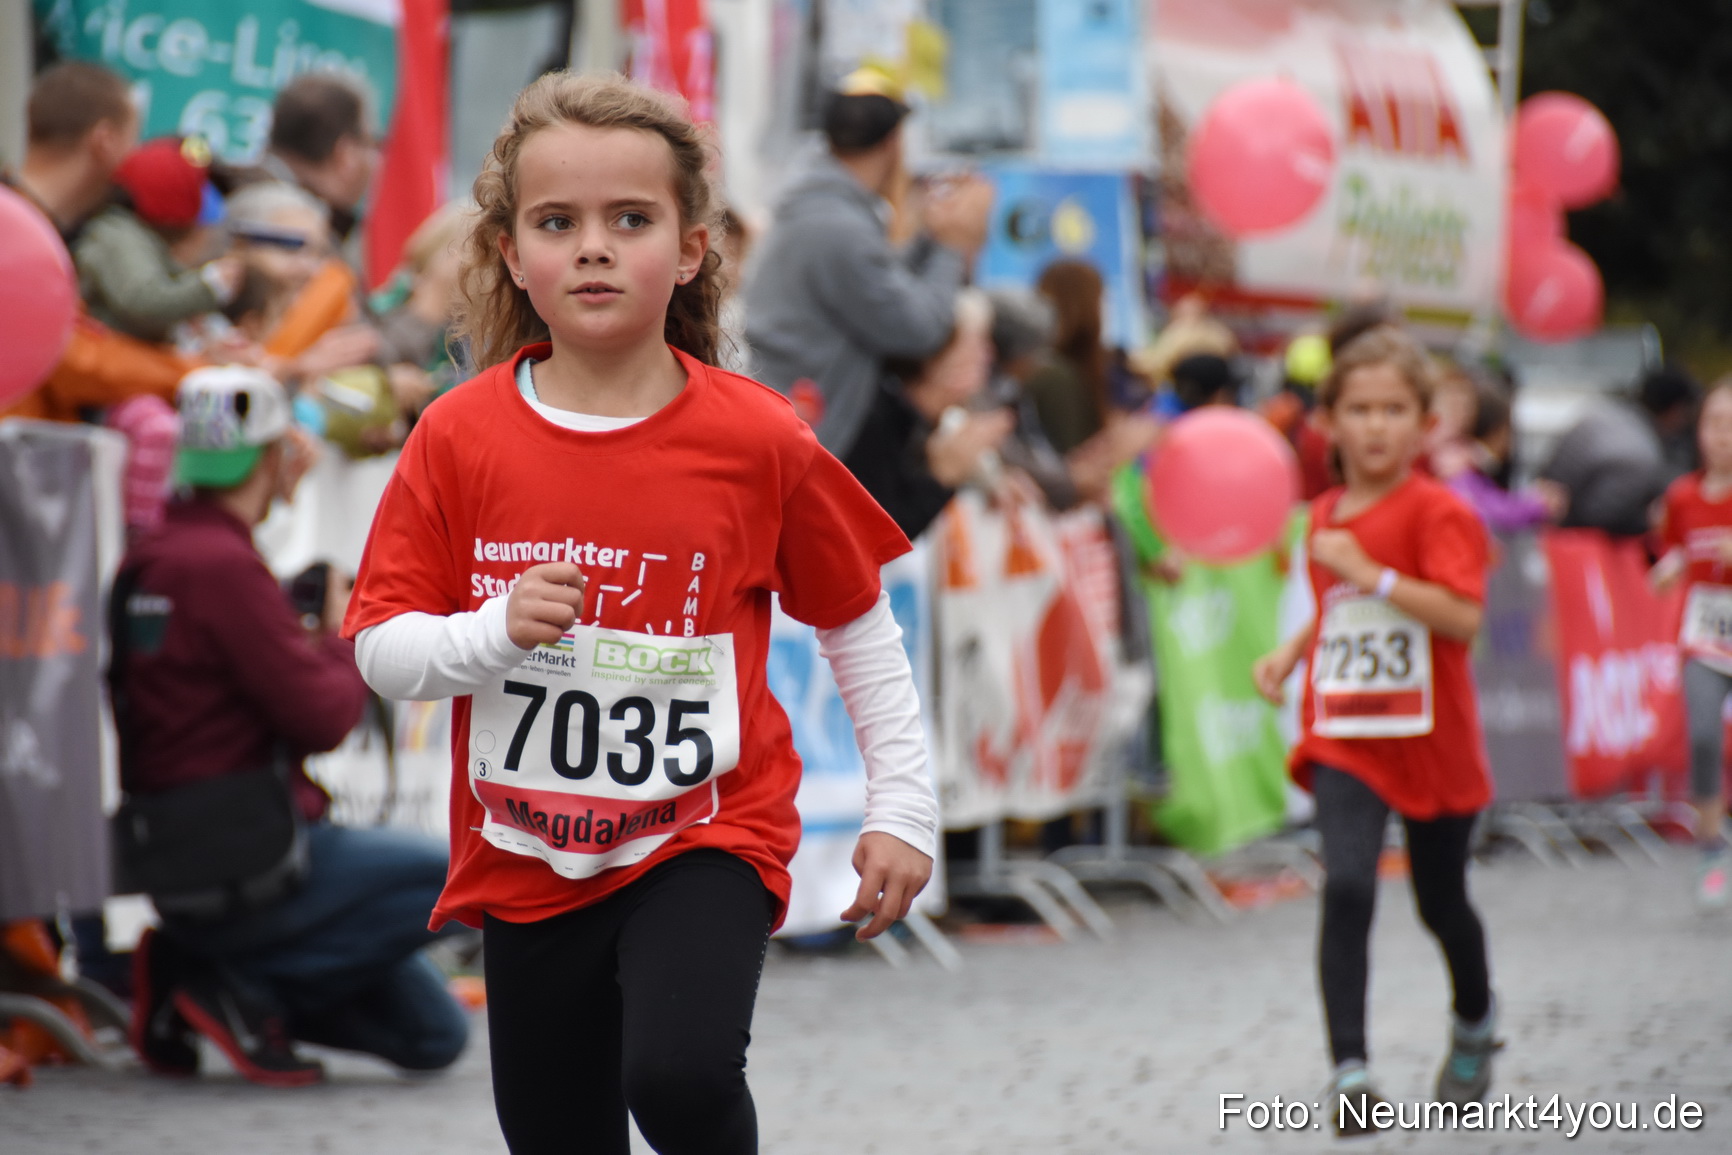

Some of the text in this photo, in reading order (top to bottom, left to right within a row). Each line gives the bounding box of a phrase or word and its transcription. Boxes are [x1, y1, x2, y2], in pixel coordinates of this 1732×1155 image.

[474, 537, 629, 568] Neumarkter
[594, 638, 714, 676] BOCK
[591, 668, 632, 683] inspired
[635, 674, 647, 685] by
[649, 677, 676, 686] smart
[503, 680, 714, 787] 7035
[479, 761, 487, 777] 3
[504, 797, 677, 849] Magdalena
